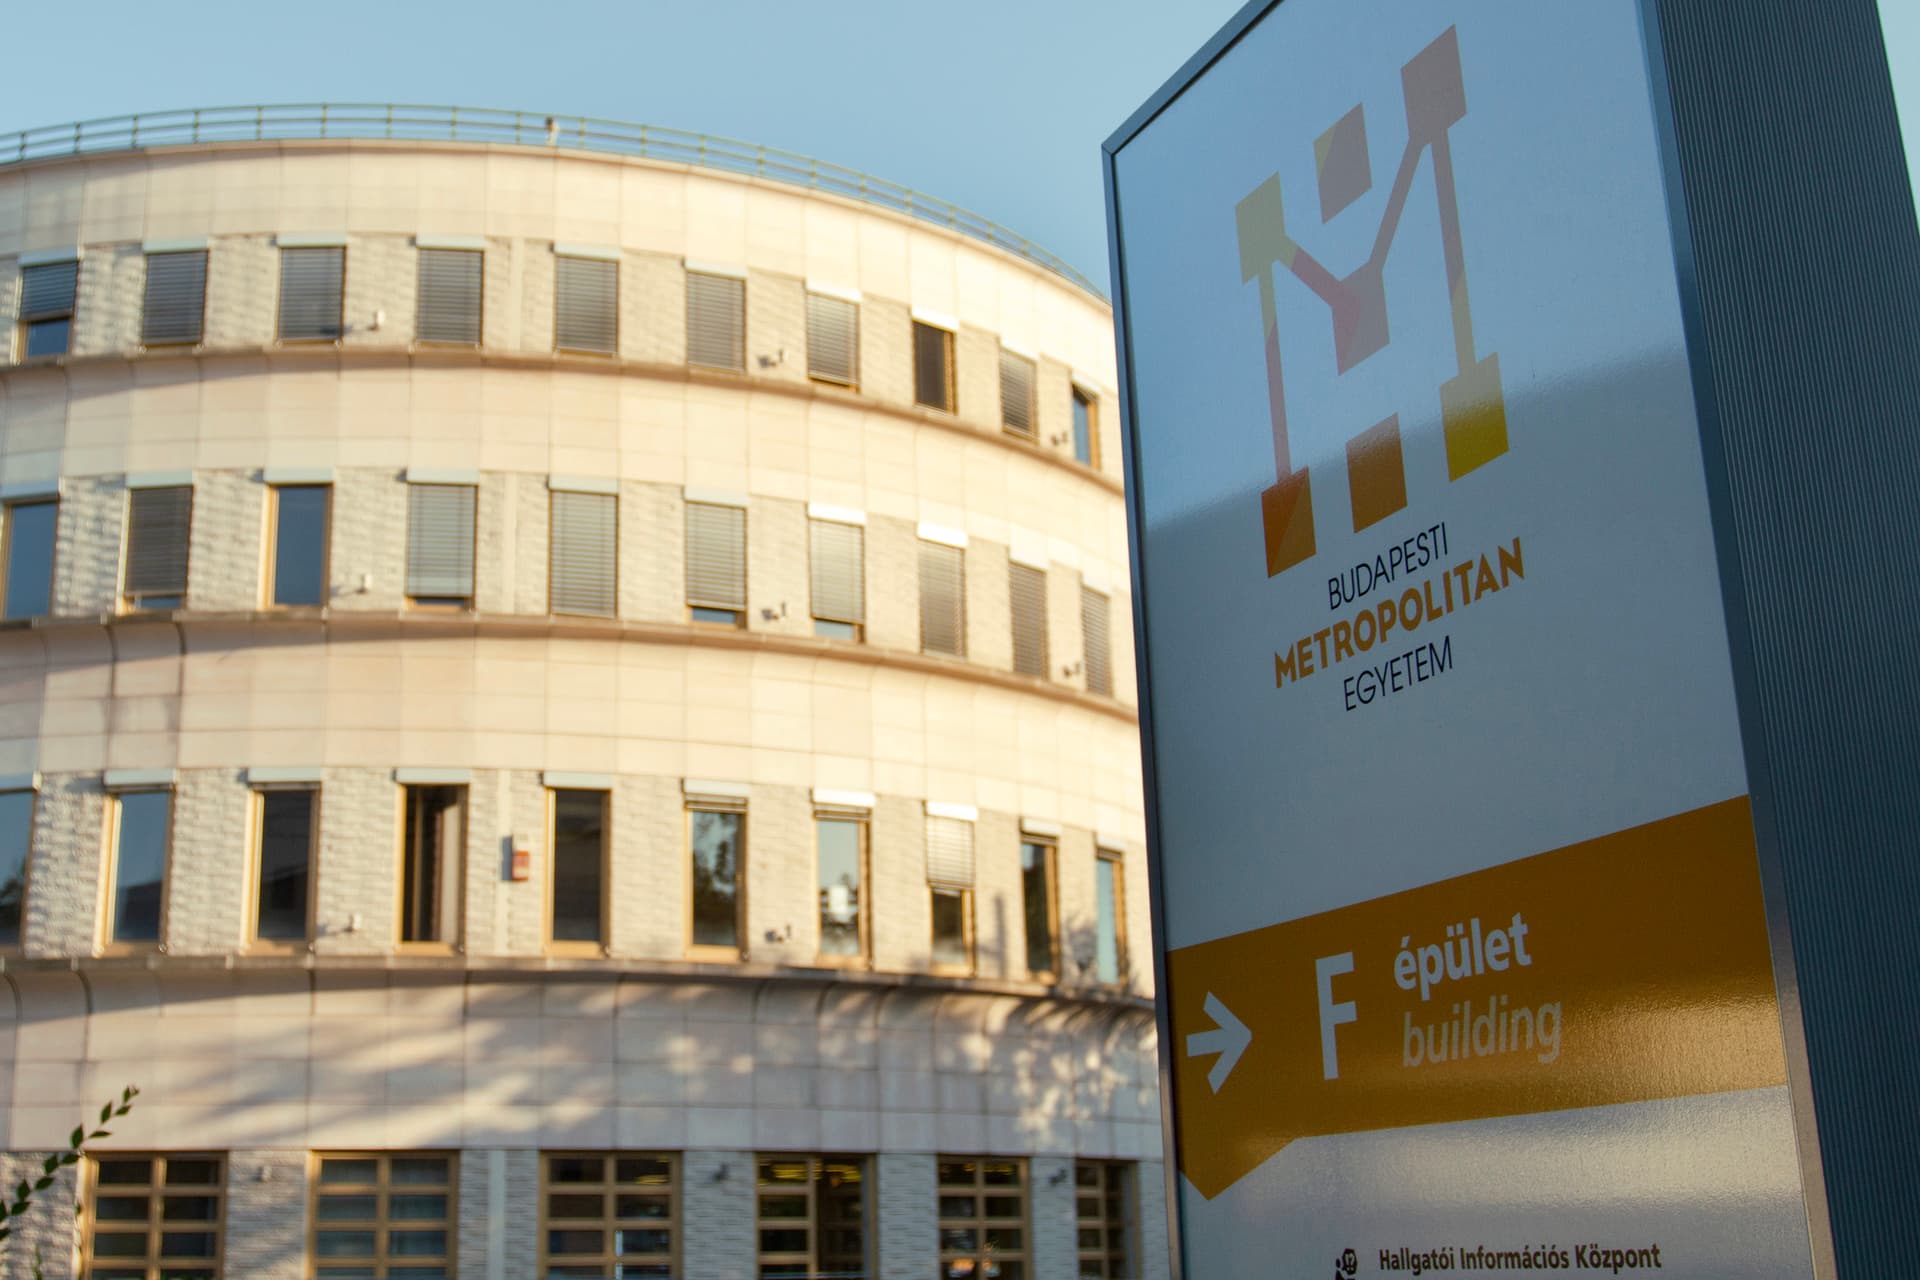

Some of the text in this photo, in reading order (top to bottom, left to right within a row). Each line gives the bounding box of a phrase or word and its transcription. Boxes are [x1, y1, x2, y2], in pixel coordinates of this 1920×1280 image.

[1328, 521, 1448, 610] BUDAPESTI
[1274, 536, 1525, 689] METROPOLITAN
[1343, 635, 1453, 712] EGYETEM
[1315, 912, 1532, 1081] F épület
[1402, 995, 1562, 1066] building
[1379, 1243, 1663, 1276] Hallgatói Információs Központ
